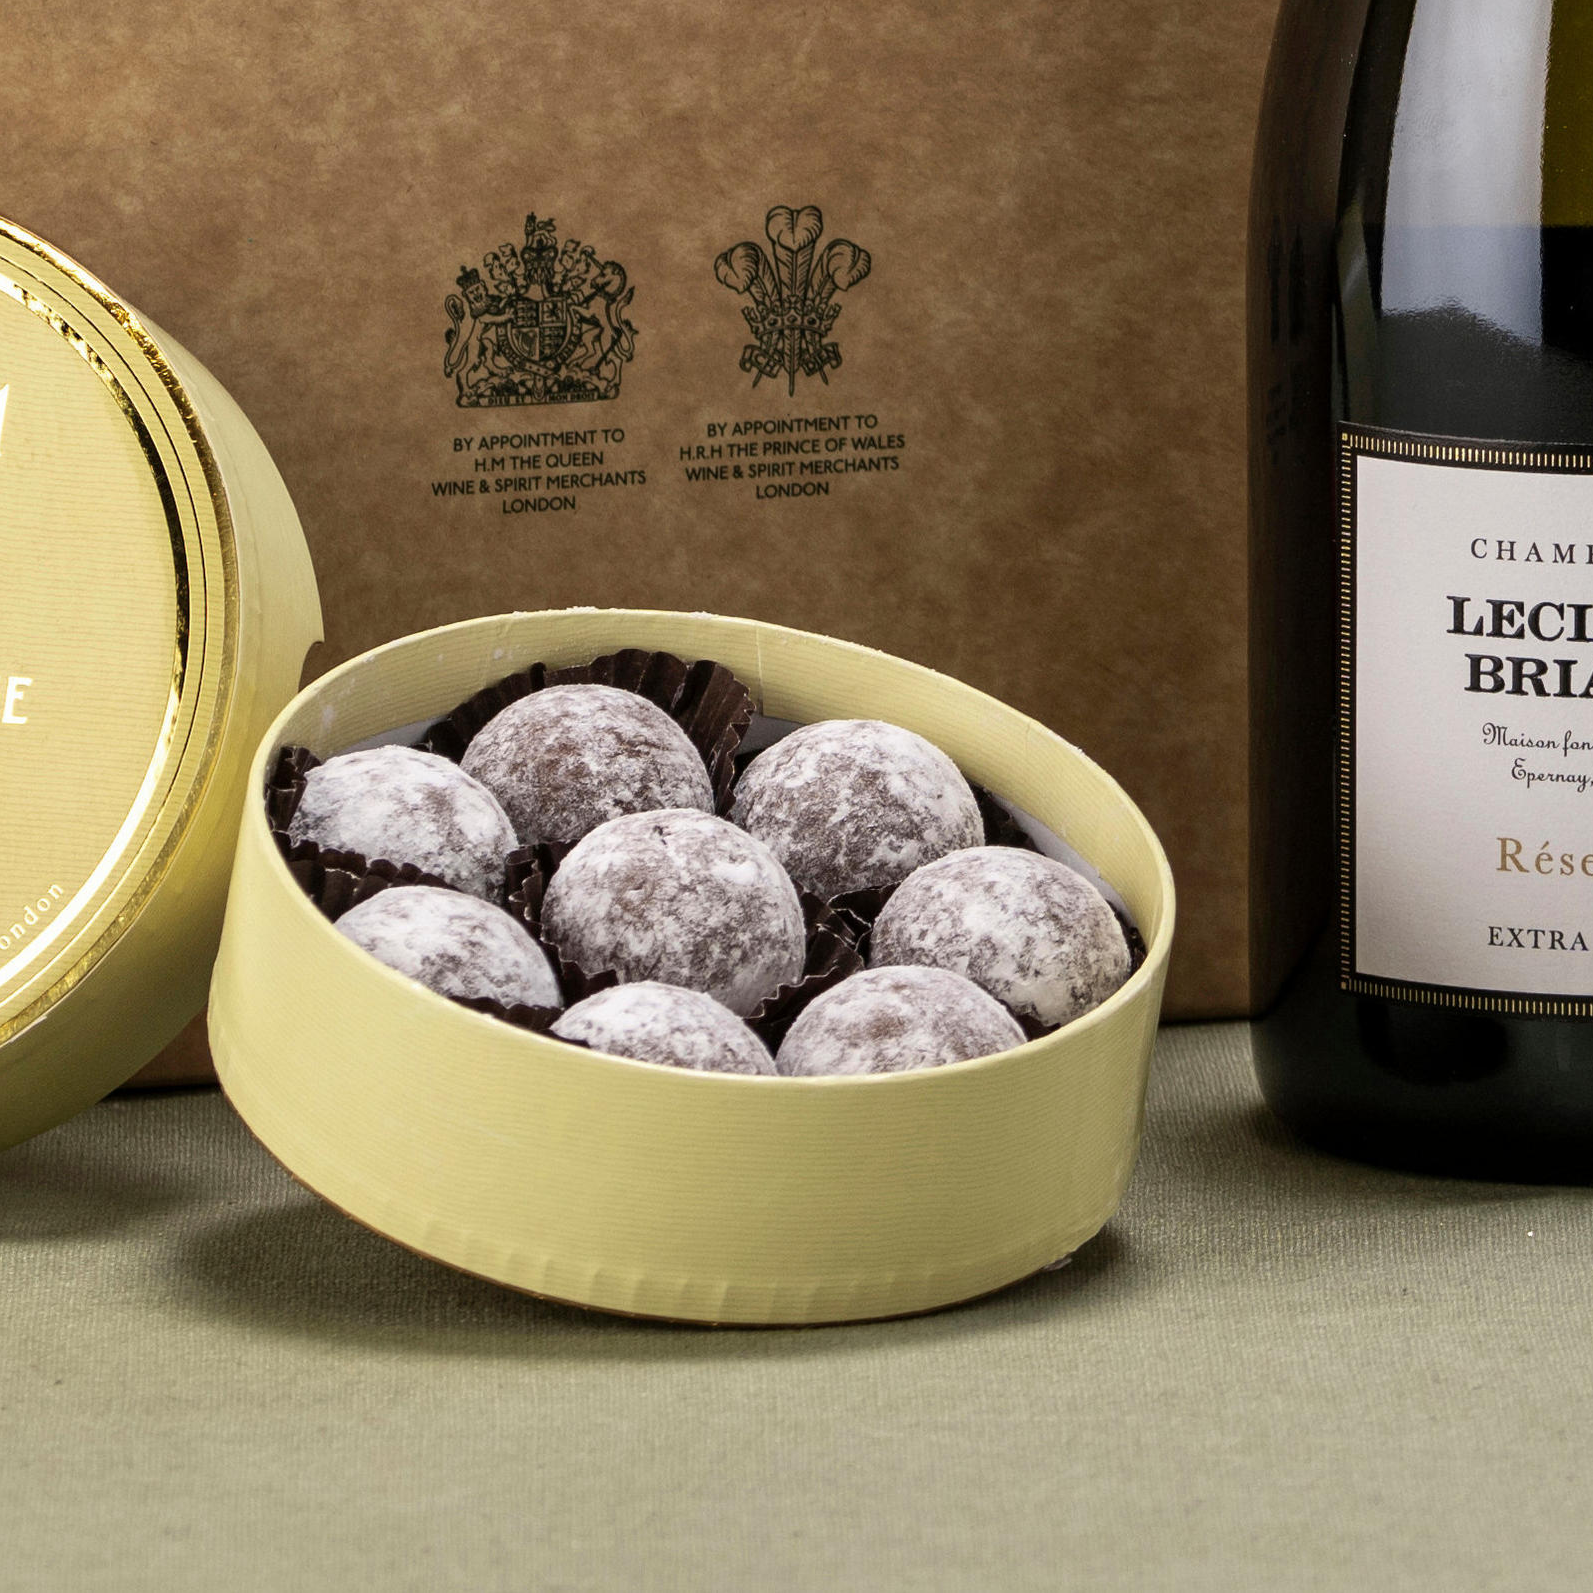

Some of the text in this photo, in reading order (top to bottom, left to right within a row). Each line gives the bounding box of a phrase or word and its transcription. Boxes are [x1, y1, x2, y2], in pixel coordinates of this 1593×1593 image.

[707, 414, 878, 438] BY APPOINTMENT TO
[453, 428, 625, 452] BY APPOINTMENT TO
[679, 434, 905, 461] H.R.H THE PRINCE OF WALES
[474, 452, 604, 472] H.M THE QUEEN
[685, 456, 899, 482] WINE & SPIRIT MERCHANTS
[432, 470, 646, 496] WINE & SPIRIT MERCHANTS
[756, 482, 829, 499] LONDON
[503, 496, 576, 514] LONDON
[1482, 722, 1560, 751] Maison
[1510, 758, 1593, 792] Epernay,
[1487, 926, 1589, 952] EXTRA
